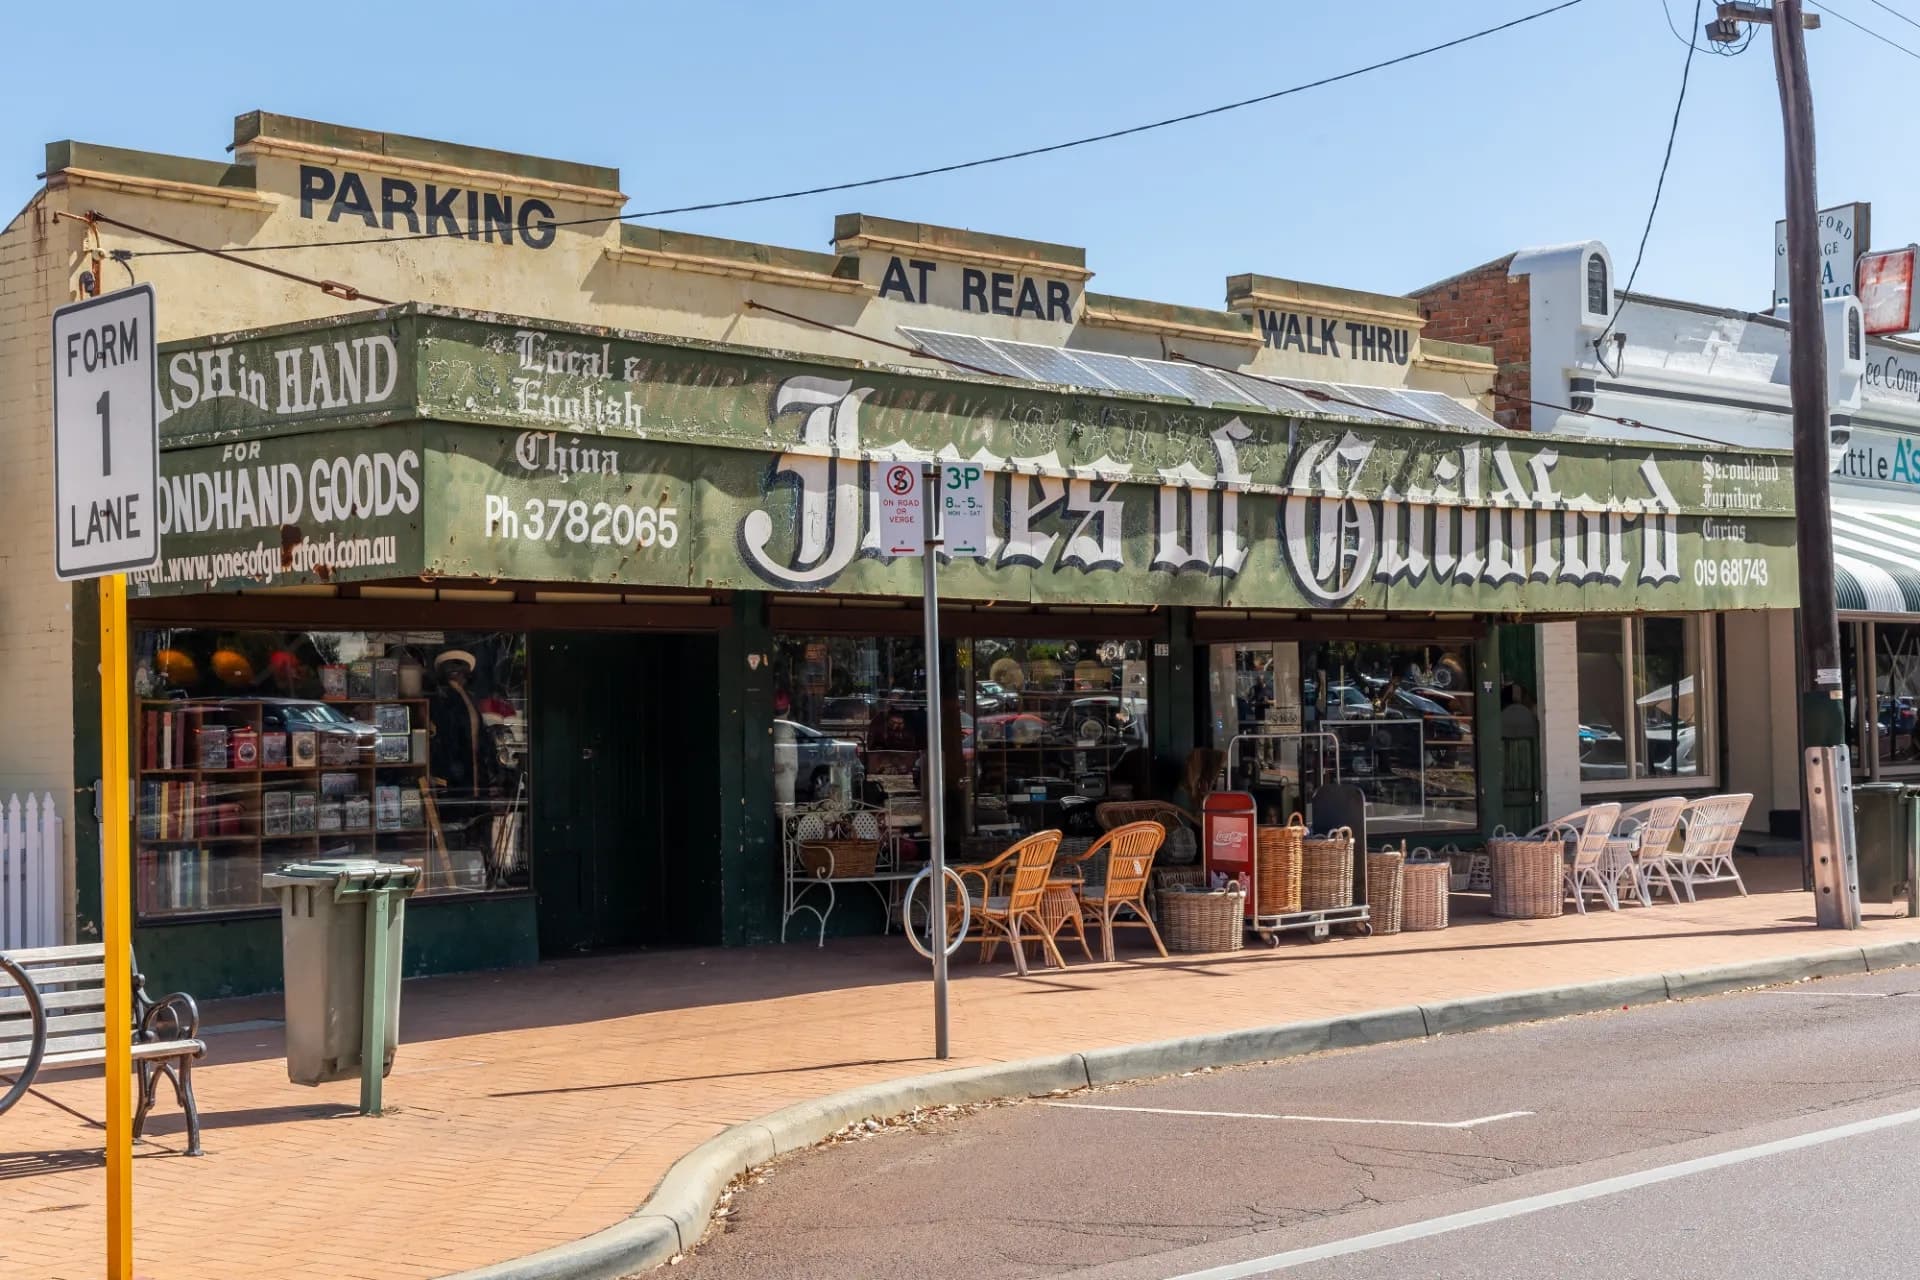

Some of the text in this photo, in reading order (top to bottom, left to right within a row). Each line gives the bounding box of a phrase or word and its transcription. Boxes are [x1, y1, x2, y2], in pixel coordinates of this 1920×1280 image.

[299, 165, 557, 250] PARKING
[878, 256, 1073, 324] AT REAR
[67, 317, 138, 377] FORM
[514, 330, 614, 381] Local
[1258, 309, 1409, 366] WALK THRU
[238, 354, 269, 411] in
[275, 335, 398, 414] HAND
[1885, 356, 1920, 402] Com
[96, 390, 111, 477] 1
[512, 377, 648, 440] English
[222, 441, 261, 463] FOR
[515, 431, 619, 483] China
[947, 467, 980, 489] 3P
[1832, 448, 1888, 479] ittle
[309, 449, 420, 524] GOODS
[883, 499, 920, 507] ON ROAD
[896, 507, 907, 515] OR
[1152, 416, 1253, 577] of
[1278, 429, 1682, 607] Guildford
[71, 493, 141, 547] LANE
[485, 494, 678, 549] Ph 3782065
[889, 515, 915, 523] VERGE
[1703, 517, 1746, 541] Curios
[1694, 558, 1768, 586] 019 681743
